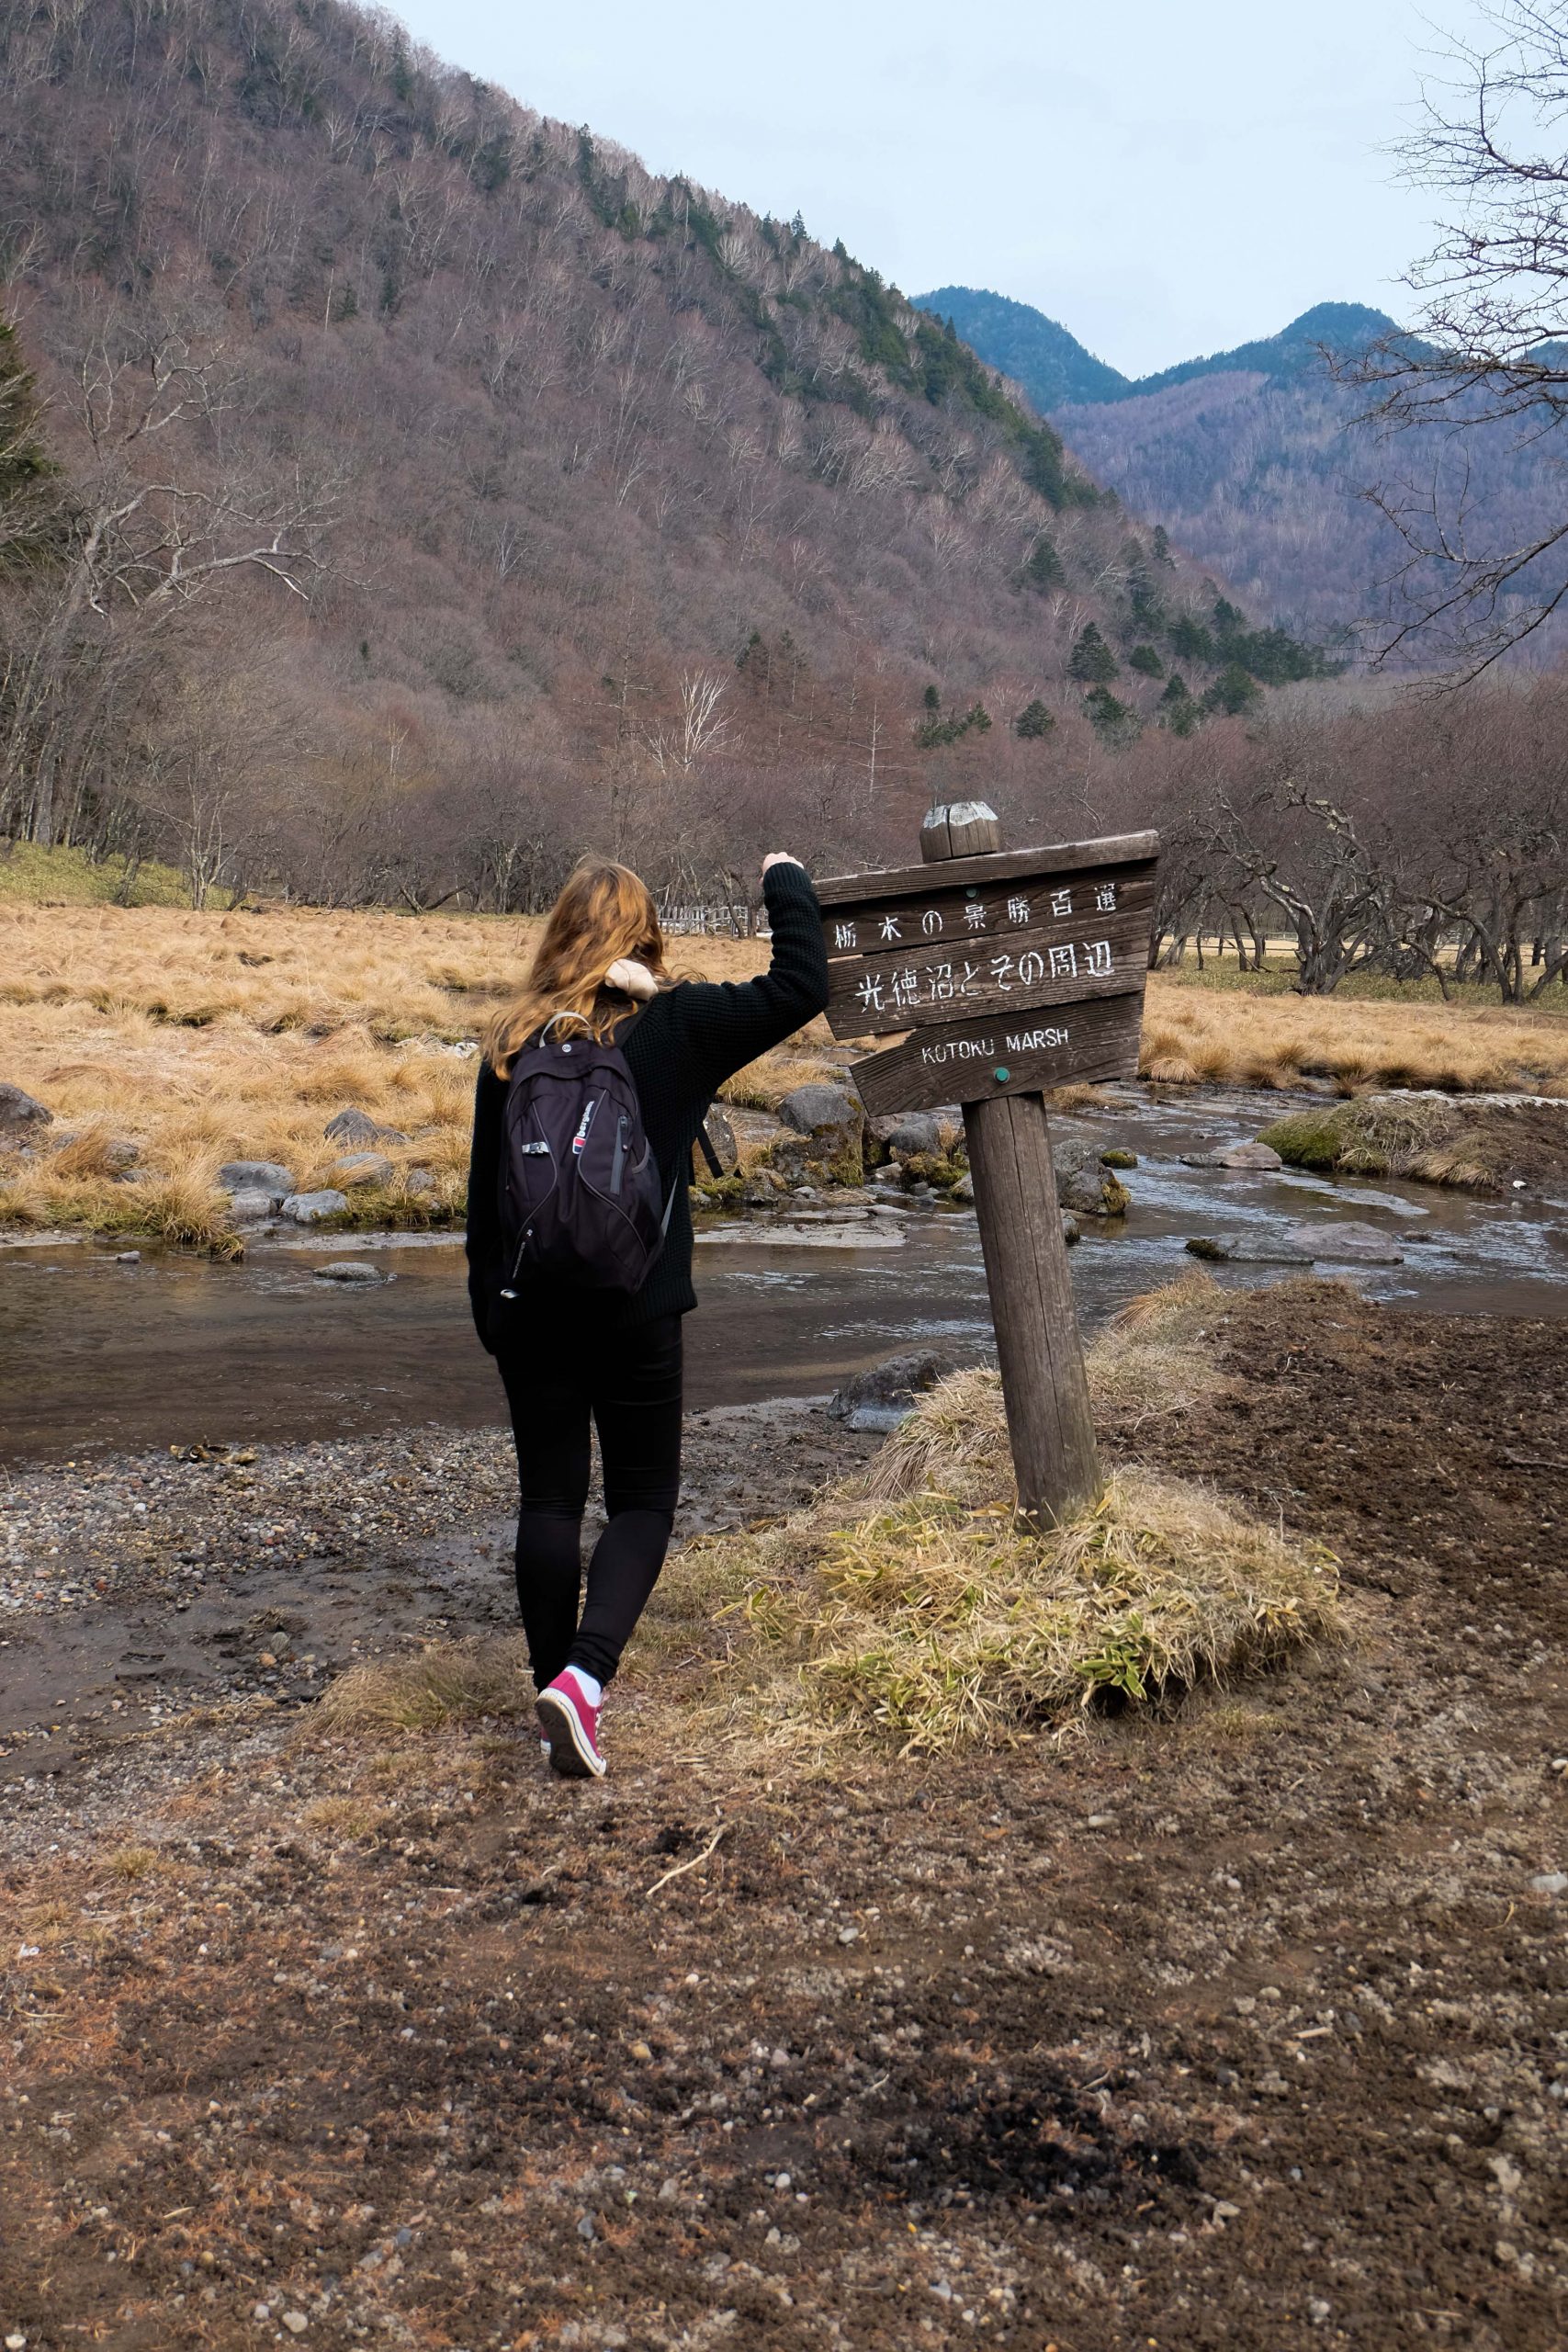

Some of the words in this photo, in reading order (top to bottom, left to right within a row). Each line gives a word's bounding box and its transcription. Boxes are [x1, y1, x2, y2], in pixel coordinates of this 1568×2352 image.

[855, 941, 1115, 1012] 光徳沼とその周辺
[922, 1039, 995, 1064] KOTOKU
[1007, 1028, 1068, 1053] MARSH
